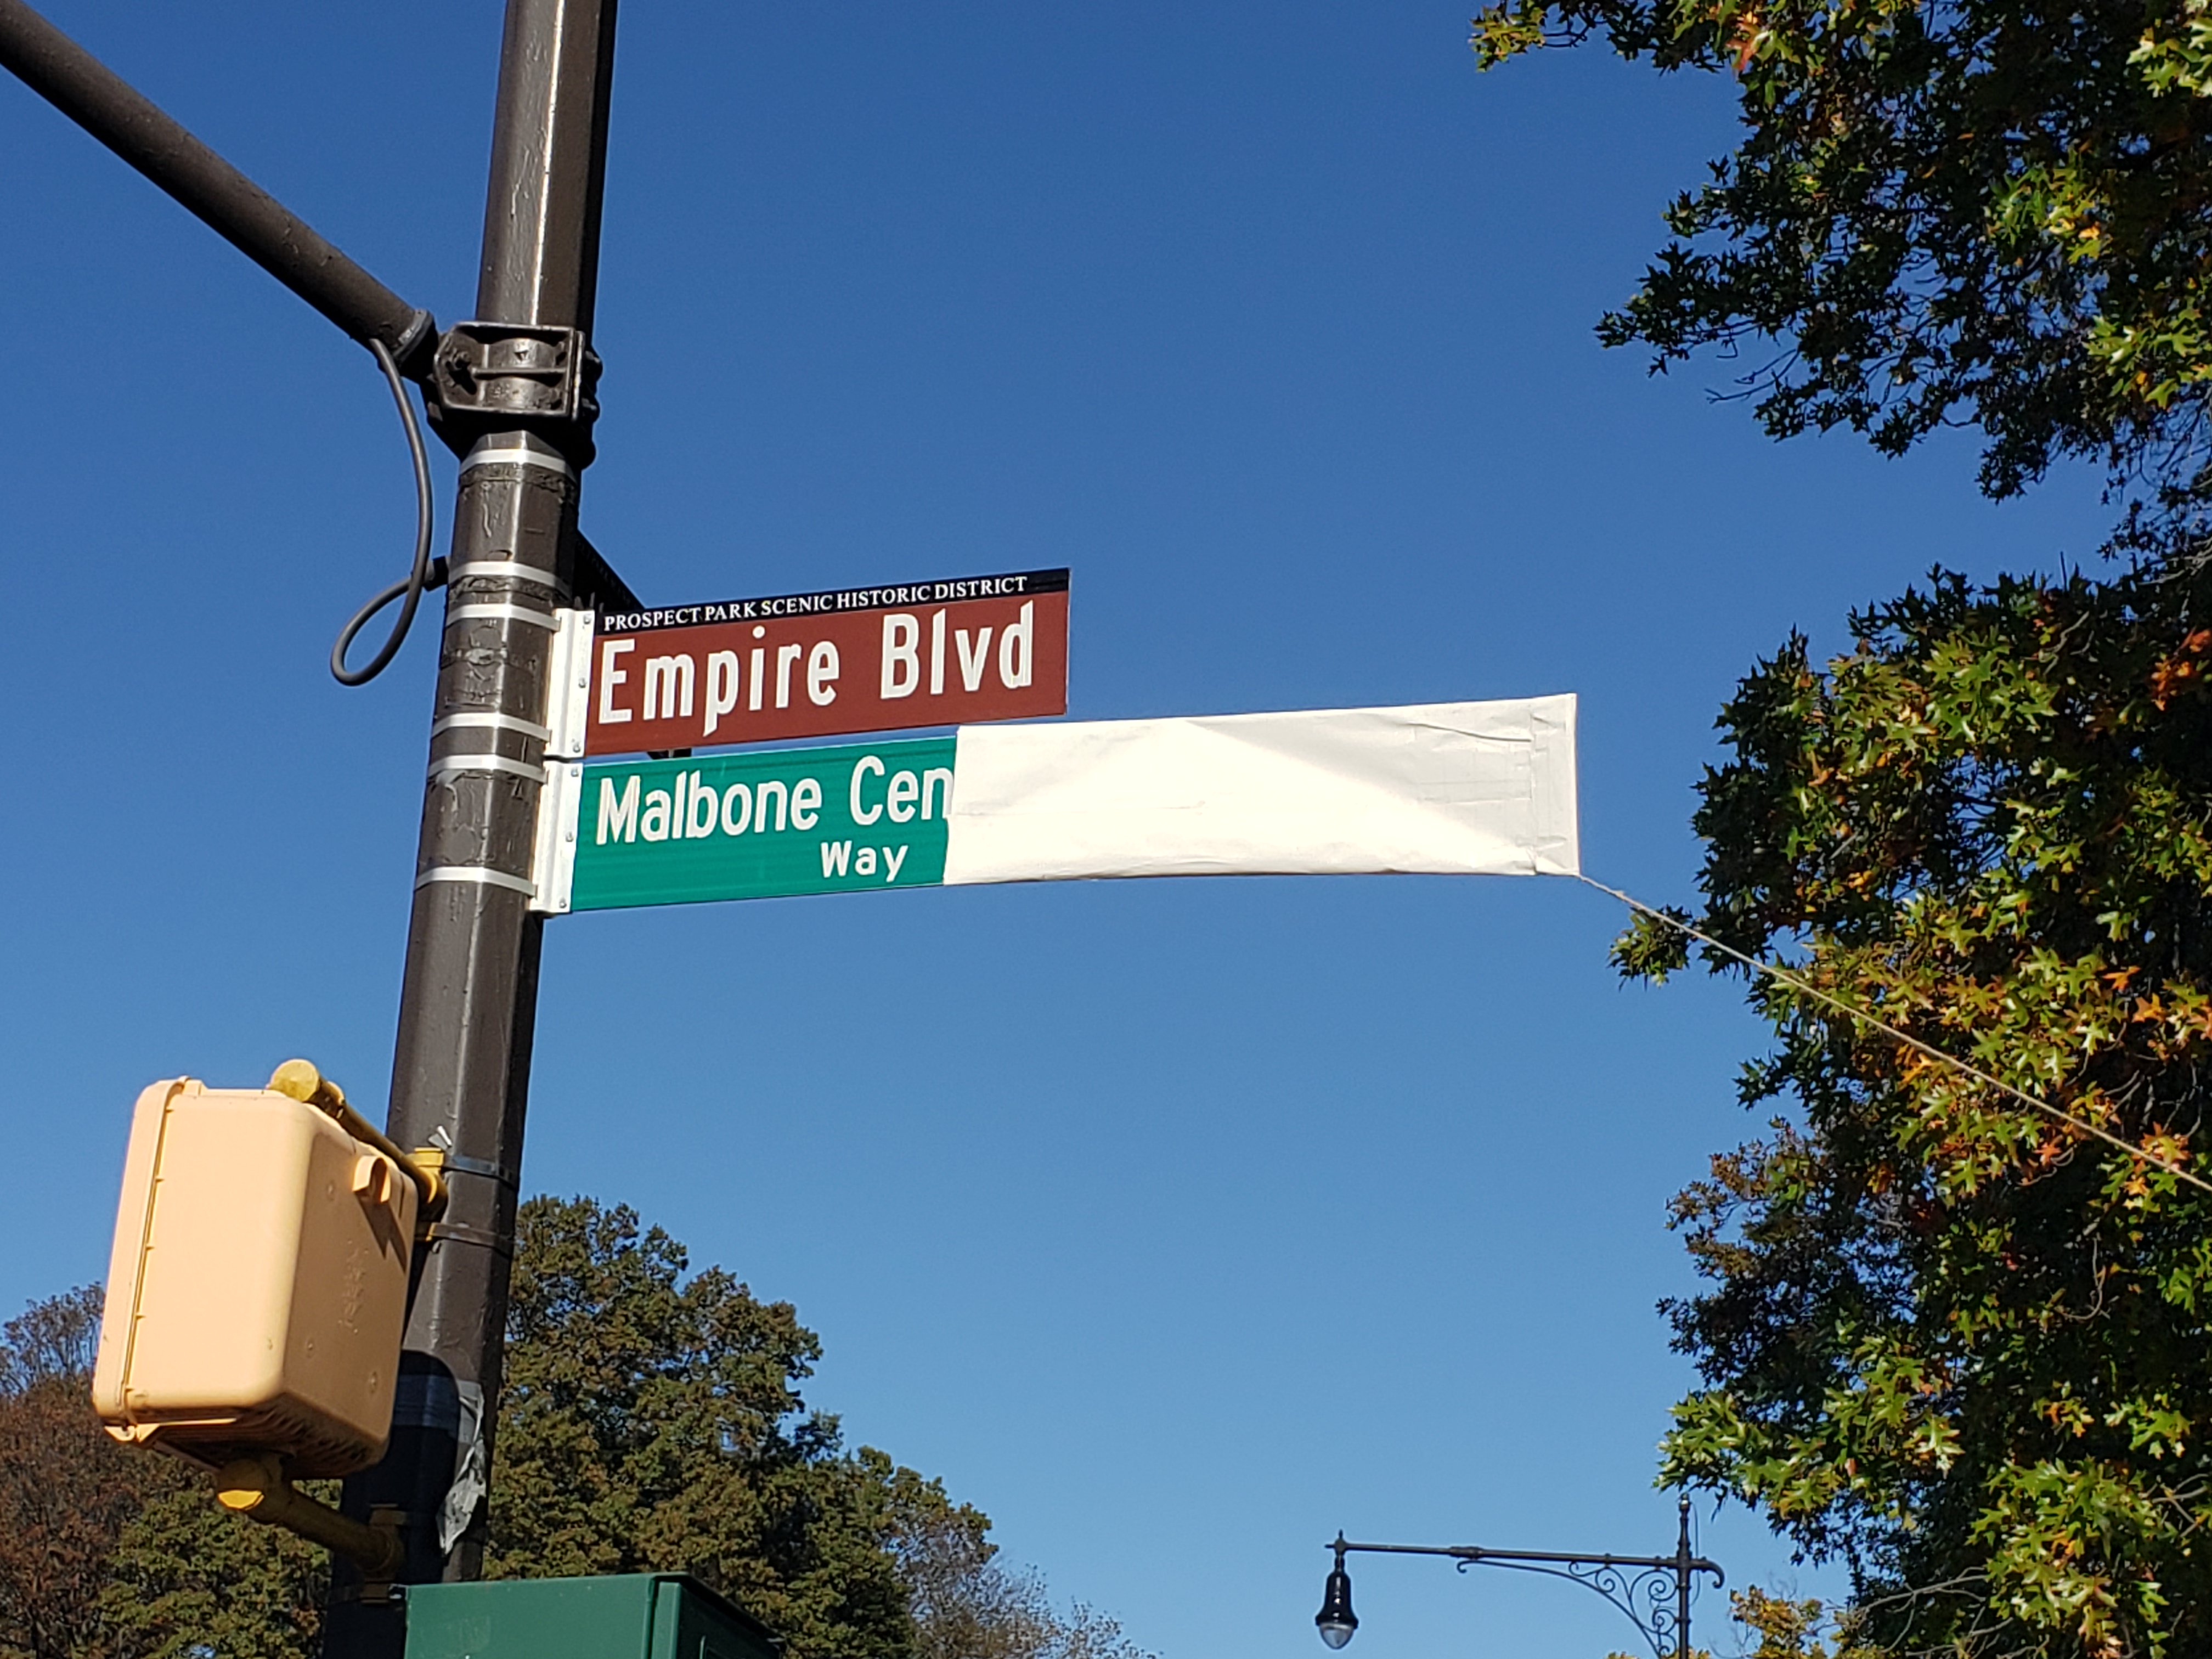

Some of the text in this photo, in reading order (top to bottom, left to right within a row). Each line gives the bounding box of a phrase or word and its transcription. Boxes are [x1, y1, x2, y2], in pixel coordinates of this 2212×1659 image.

[604, 576, 1027, 631] PROSPECT PARK SCENIC HISTORIC DISTRICT
[599, 600, 1034, 737] Empire Blvd
[596, 770, 822, 845] Malbone
[821, 840, 909, 882] Way
